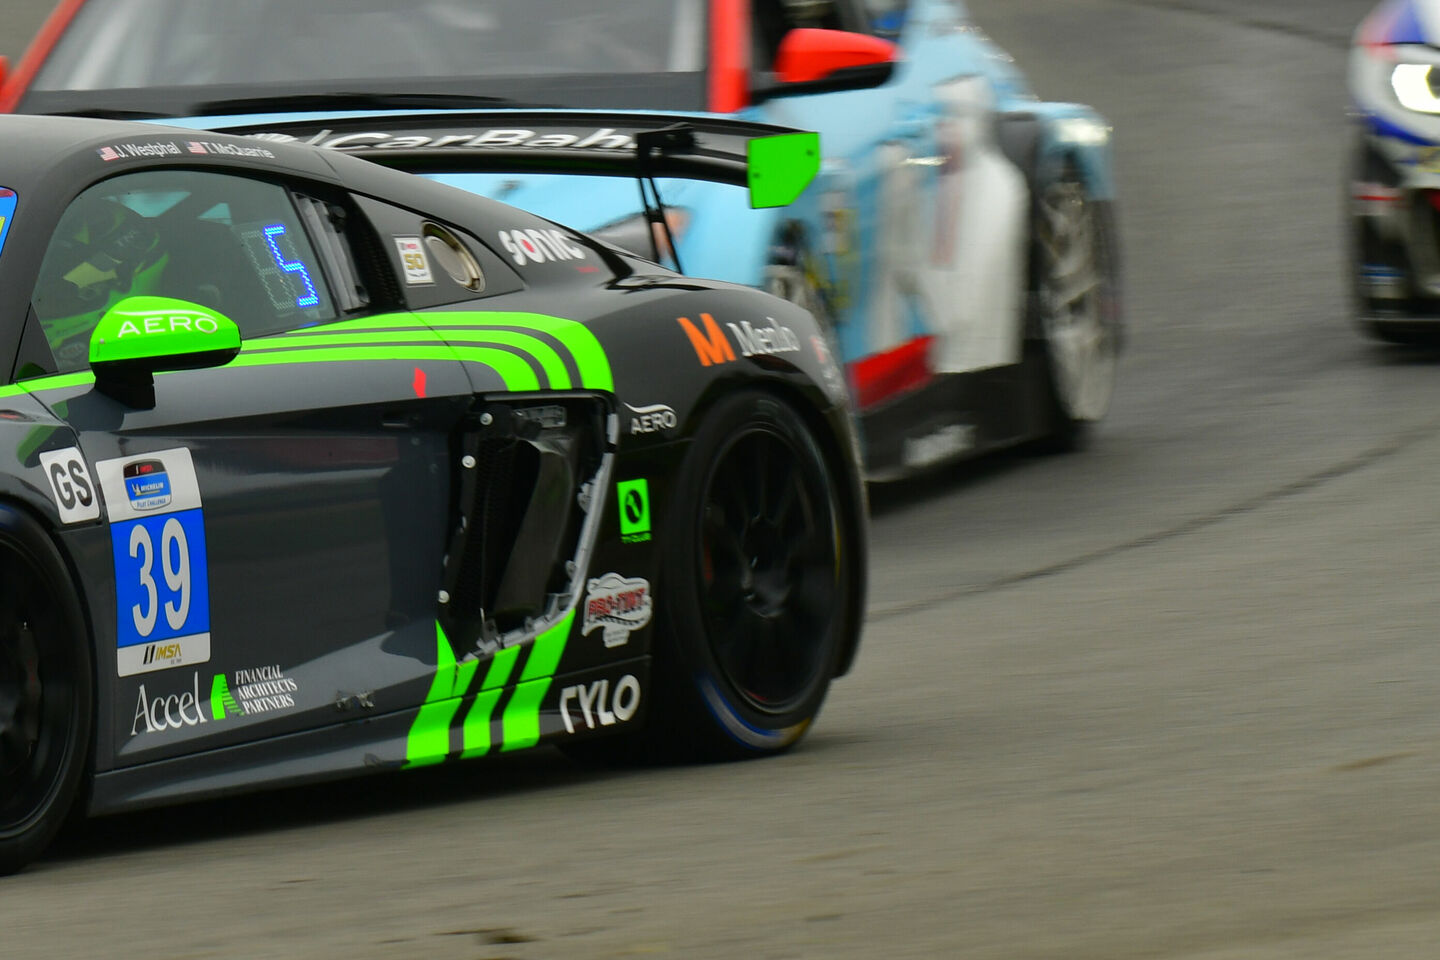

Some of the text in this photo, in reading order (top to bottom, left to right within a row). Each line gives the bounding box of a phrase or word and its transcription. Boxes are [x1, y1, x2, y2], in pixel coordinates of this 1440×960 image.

[124, 141, 182, 158] Westphal
[327, 128, 662, 152] CarBah
[117, 315, 219, 339] AERO
[726, 316, 801, 357] Menlo
[631, 410, 678, 435] AERO
[49, 458, 94, 511] GS
[128, 517, 192, 638] 39
[235, 664, 284, 686] FINANCIAL
[237, 677, 298, 701] ARCHITECTS
[130, 670, 208, 737] Accel
[241, 692, 295, 715] PARTNERS
